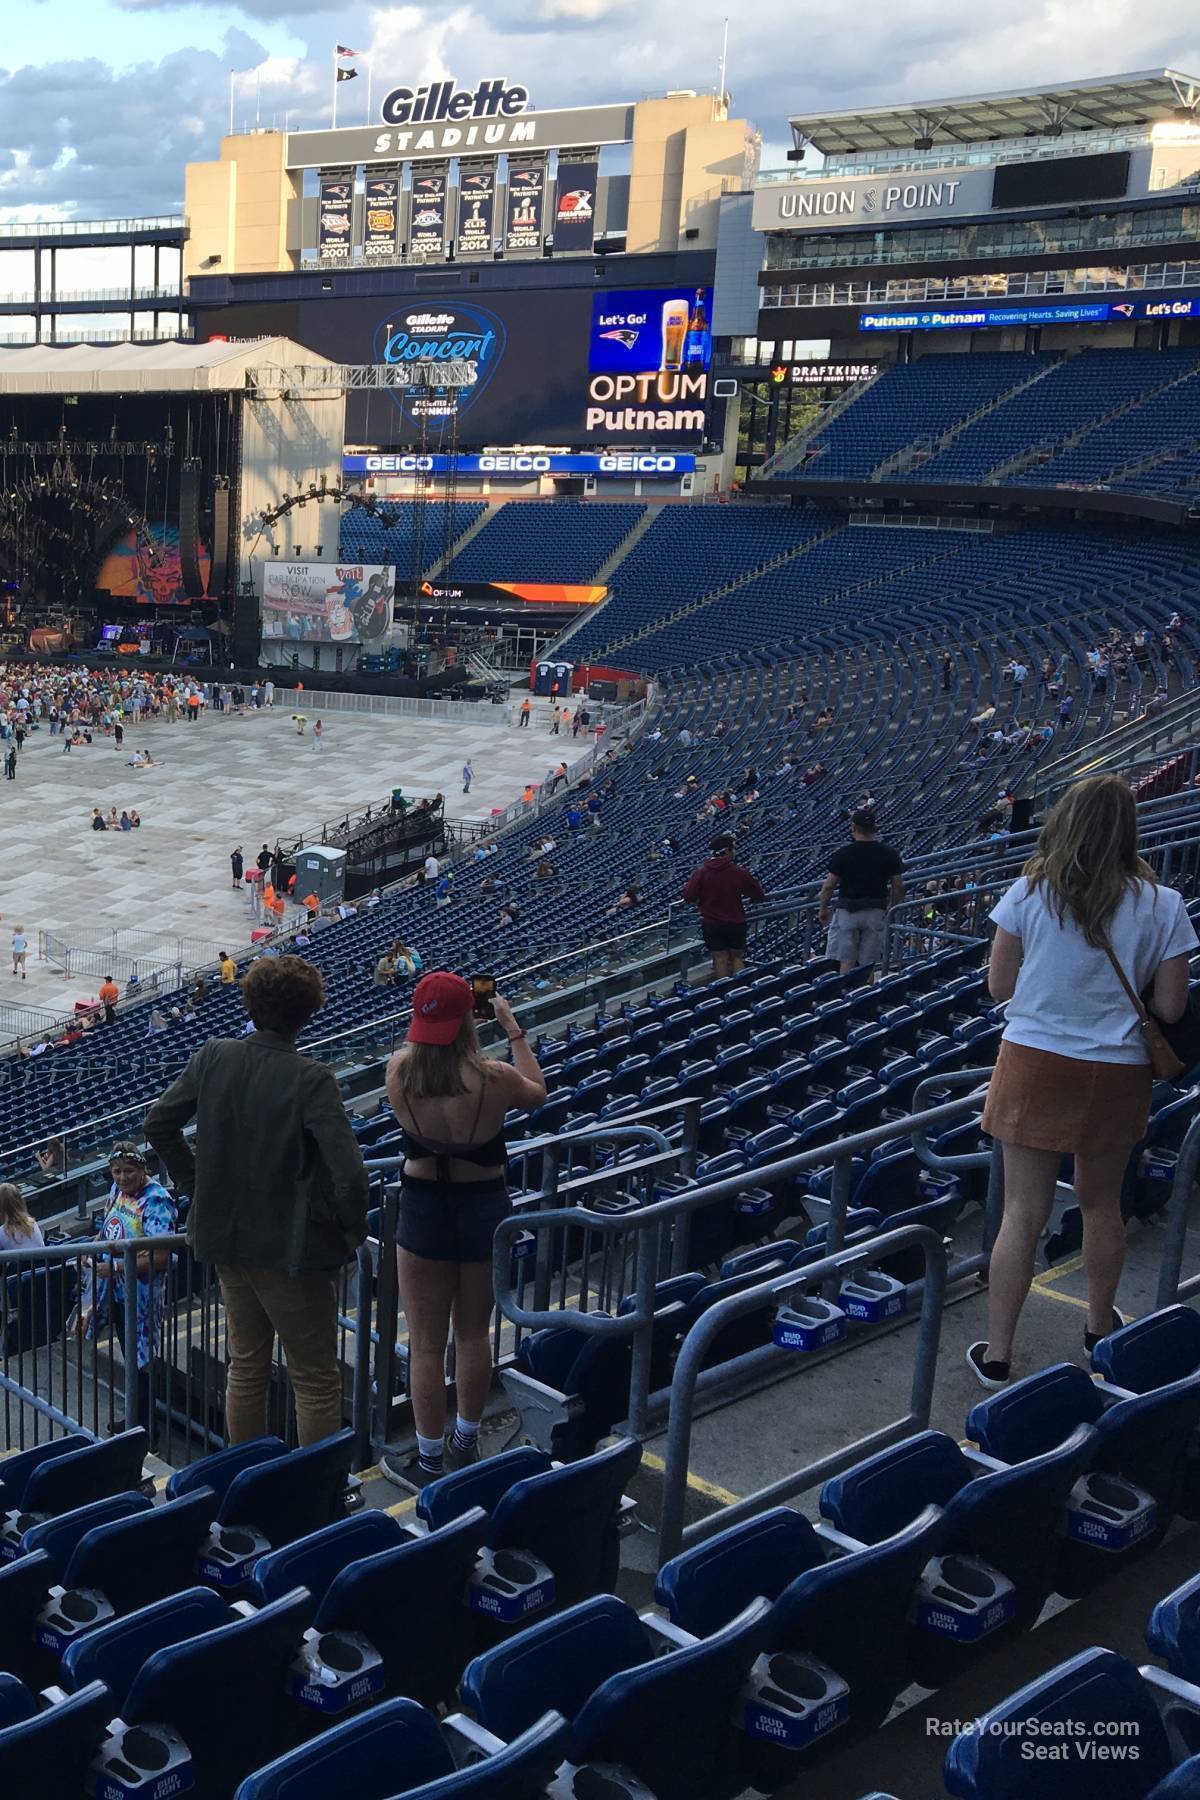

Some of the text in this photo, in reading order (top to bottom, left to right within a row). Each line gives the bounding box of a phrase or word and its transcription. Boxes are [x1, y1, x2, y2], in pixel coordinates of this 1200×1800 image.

[381, 77, 529, 127] Gillette
[374, 121, 536, 152] STADIUM
[782, 181, 960, 217] UNION POINT
[464, 220, 486, 229] XLIX
[412, 243, 442, 253] 2004
[460, 241, 488, 250] 2014
[508, 238, 538, 248] 2016
[321, 248, 348, 258] 2001
[365, 245, 394, 255] 2003
[1146, 302, 1192, 315] Let's Go!
[406, 314, 455, 325] Gillette
[600, 314, 647, 325] Let's Go!
[865, 316, 918, 327] Putnam
[932, 313, 986, 325] Putnam
[989, 312, 1028, 322] Recovering
[1055, 310, 1079, 319] Saving
[384, 330, 495, 362] Concert
[792, 365, 878, 376] DRAFTKINGS
[590, 374, 706, 401] OPTUM
[586, 408, 705, 430] Putnam
[366, 456, 433, 471] GEICO
[479, 456, 550, 471] GEICO
[600, 456, 676, 471] GEICO
[286, 566, 309, 575] VISIT
[268, 575, 326, 584] PARTICIPATION
[281, 583, 312, 597] ROW
[845, 1308, 869, 1318] LIGHT
[848, 1303, 865, 1312] BUD
[781, 1336, 803, 1346] LIGHT
[784, 1331, 801, 1340] BUD
[1082, 1521, 1105, 1532] BUD
[1078, 1526, 1108, 1541] LIGHT
[478, 1600, 502, 1614] LIGHT
[482, 1595, 500, 1606] BUD
[932, 1611, 955, 1623] BUD
[928, 1617, 959, 1632] LIGHT
[300, 1689, 324, 1704] LIGHT
[303, 1685, 320, 1696] BUD
[759, 1714, 784, 1729] BUD
[755, 1721, 788, 1738] LIGHT
[157, 1773, 178, 1790] BUD
[106, 1783, 125, 1797] BUD
[153, 1780, 181, 1800] LIGHT
